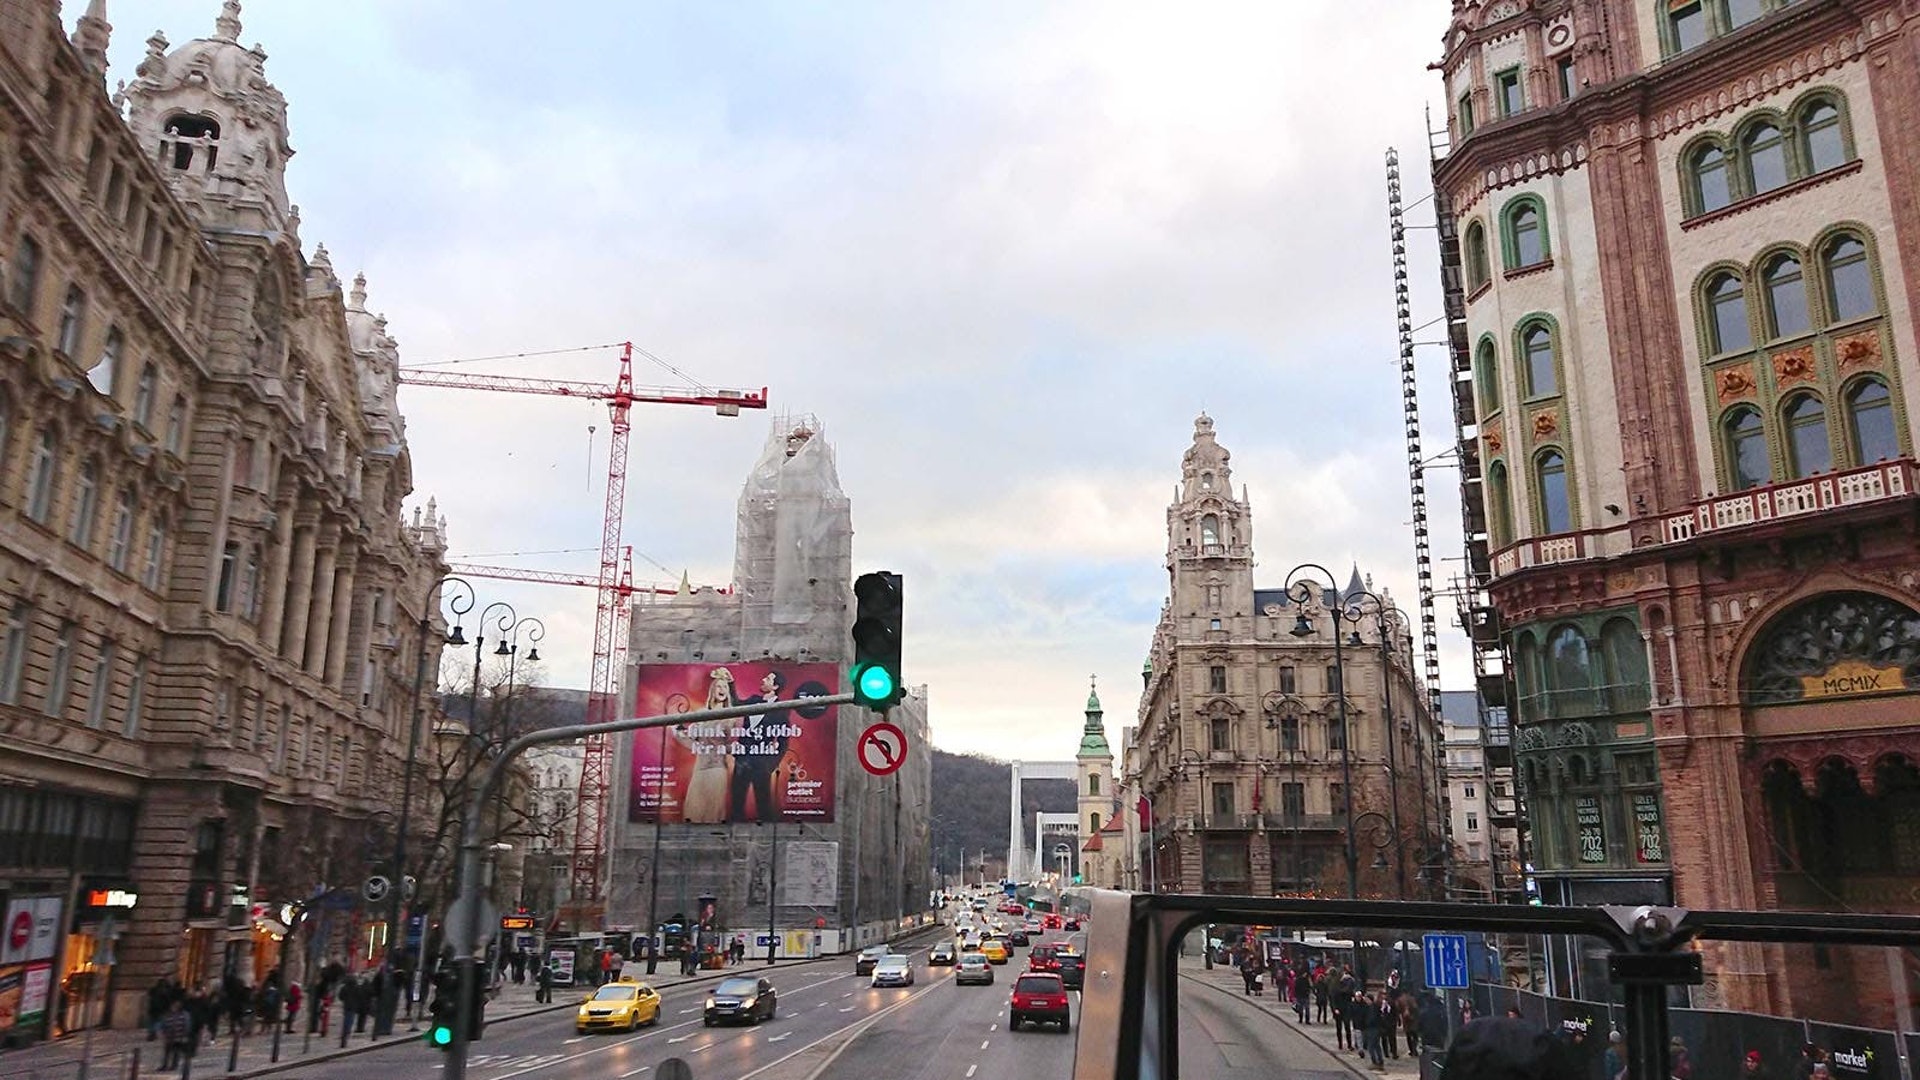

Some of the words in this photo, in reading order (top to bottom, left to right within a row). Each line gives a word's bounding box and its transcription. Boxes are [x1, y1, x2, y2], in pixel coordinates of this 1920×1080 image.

[1823, 674, 1881, 693] MCMIX
[731, 723, 764, 740] még
[766, 723, 802, 738] több
[691, 741, 714, 755] fér
[717, 745, 727, 755] a
[731, 741, 747, 755] fa
[749, 741, 780, 755] alá!
[787, 780, 823, 789] premier
[1581, 836, 1602, 850] 702
[1640, 834, 1660, 849] 702
[1583, 850, 1604, 860] 4088
[1642, 849, 1662, 860] 4088
[1563, 1017, 1587, 1031] market
[1834, 1048, 1867, 1067] market
